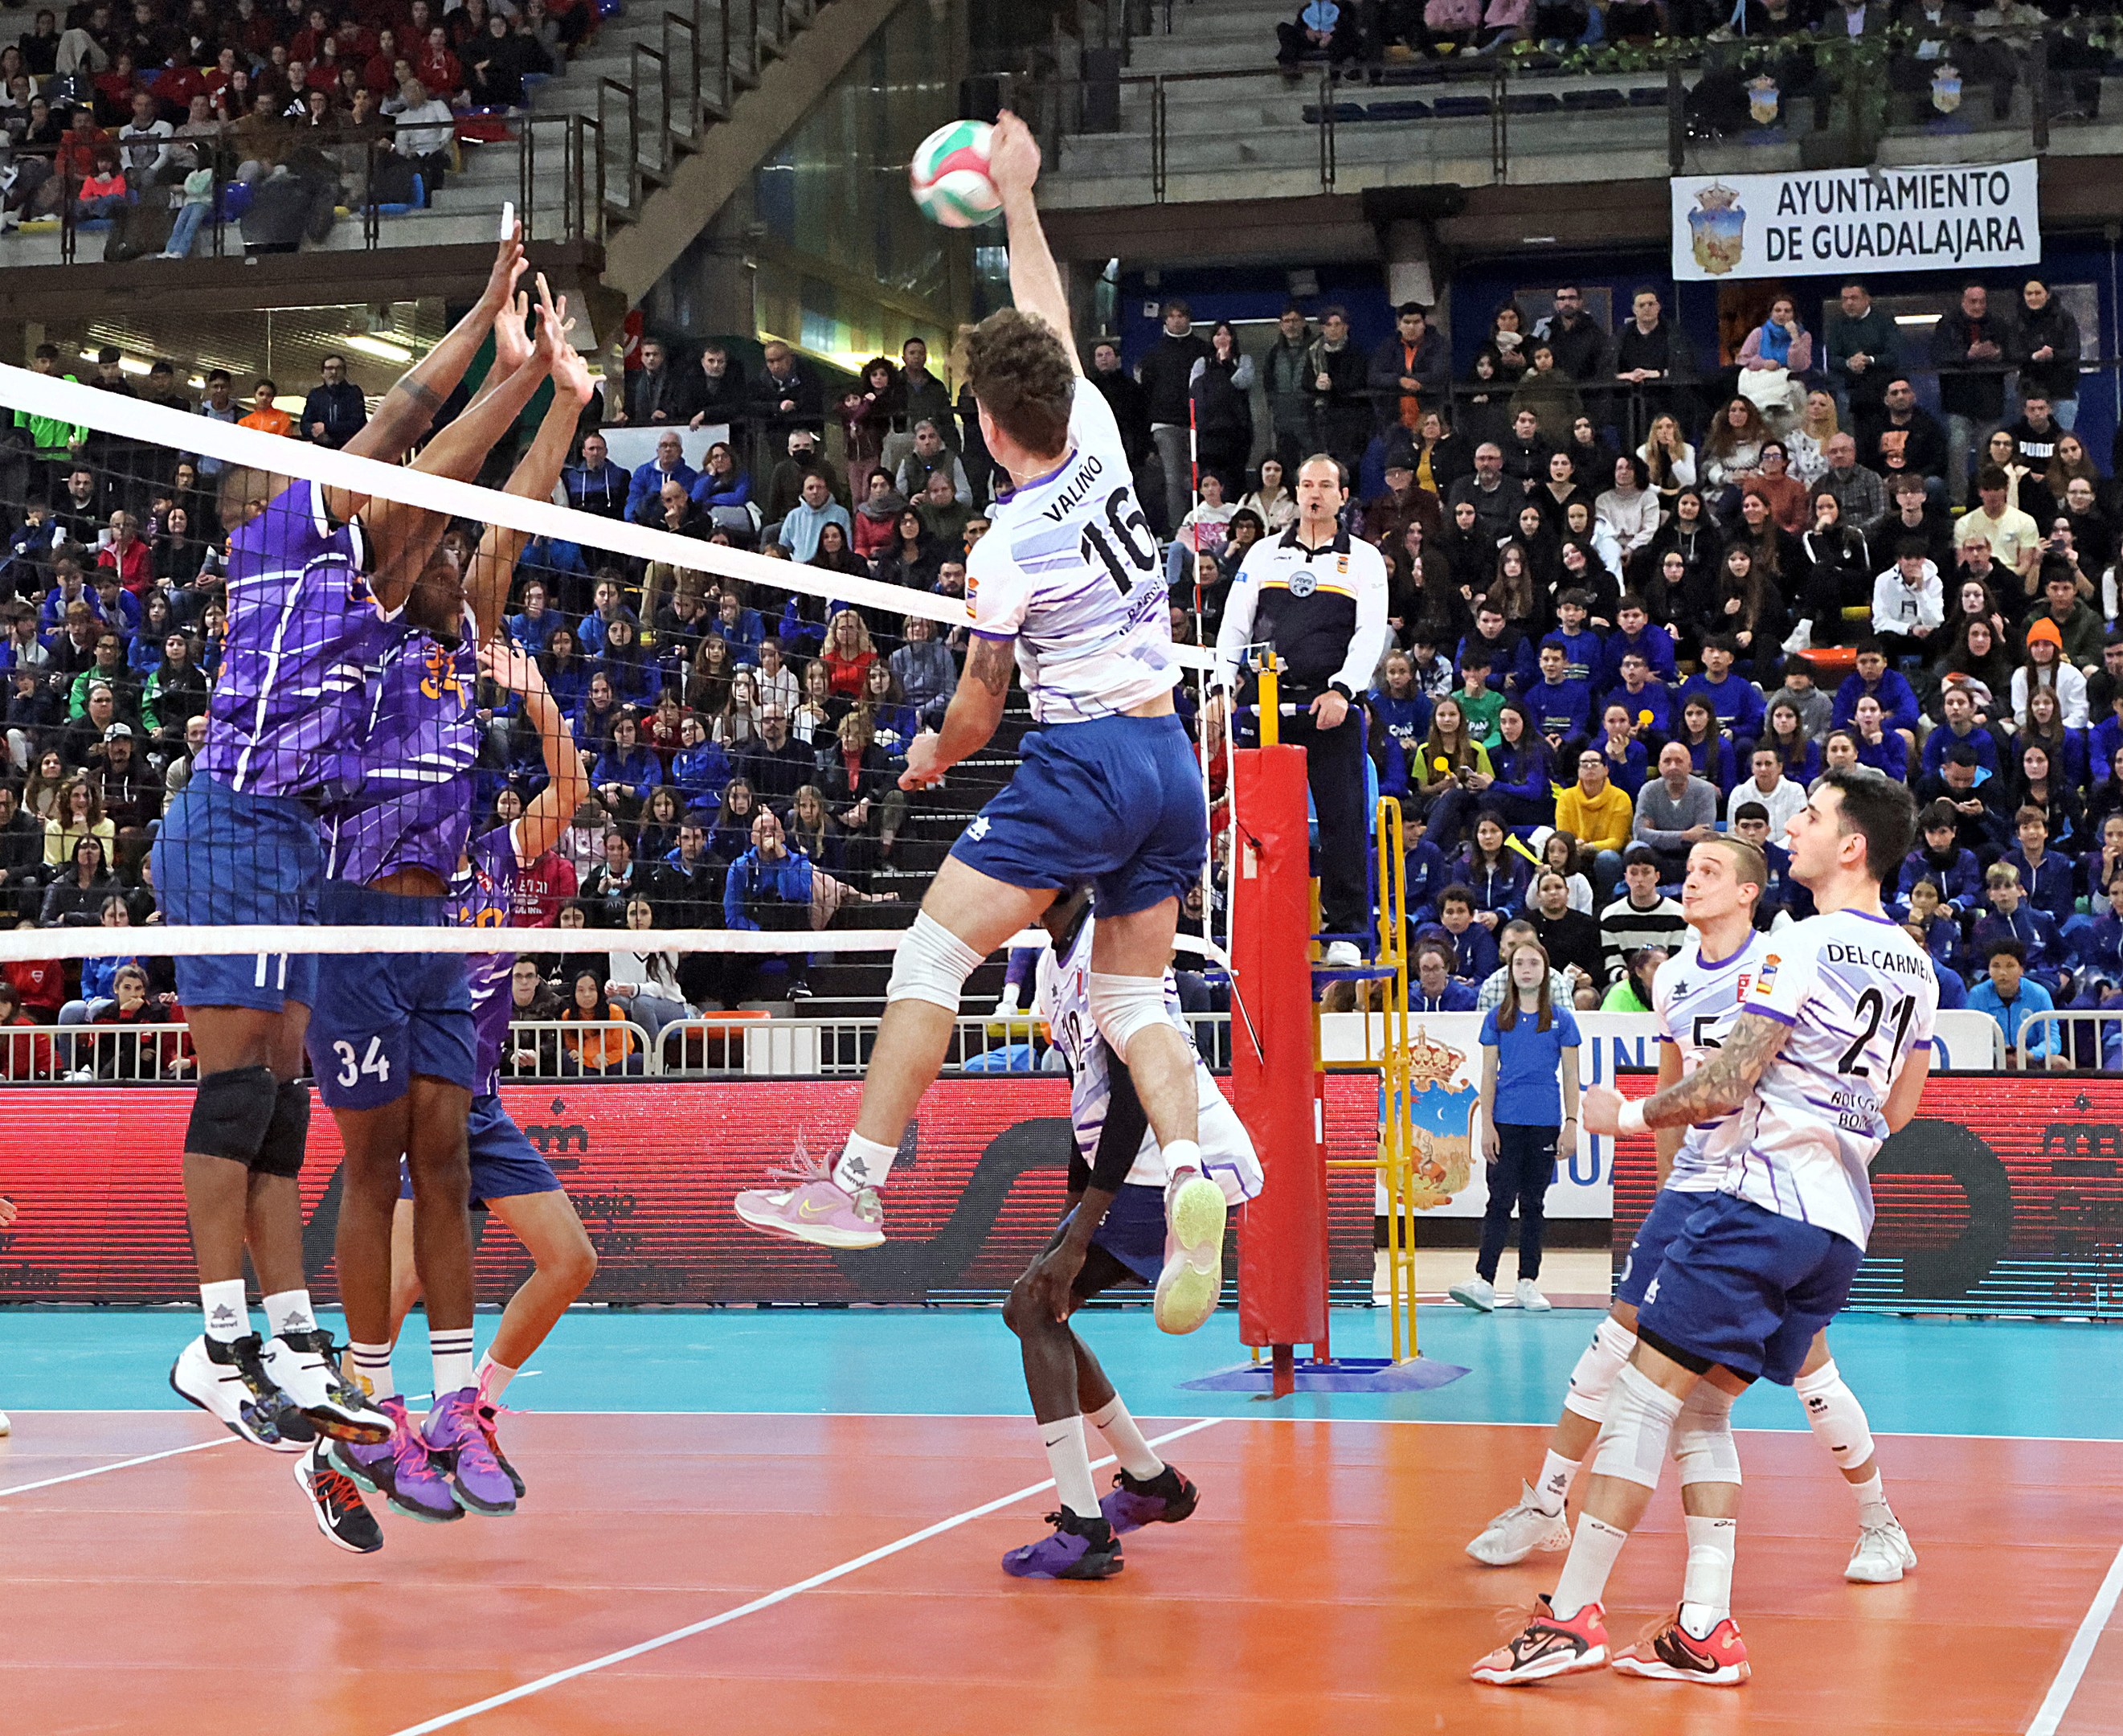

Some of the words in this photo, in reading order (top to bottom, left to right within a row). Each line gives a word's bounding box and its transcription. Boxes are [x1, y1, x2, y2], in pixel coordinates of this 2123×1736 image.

[1777, 170, 2010, 215] AYUNTAMIENTO
[1767, 226, 1802, 262] DE
[1812, 216, 2025, 263] GUADALAJARA
[1042, 455, 1102, 522] VALIÑO
[1080, 486, 1156, 596] 16
[1826, 944, 1869, 965] DEL
[333, 1035, 391, 1088] 34
[1838, 988, 1916, 1084] 21
